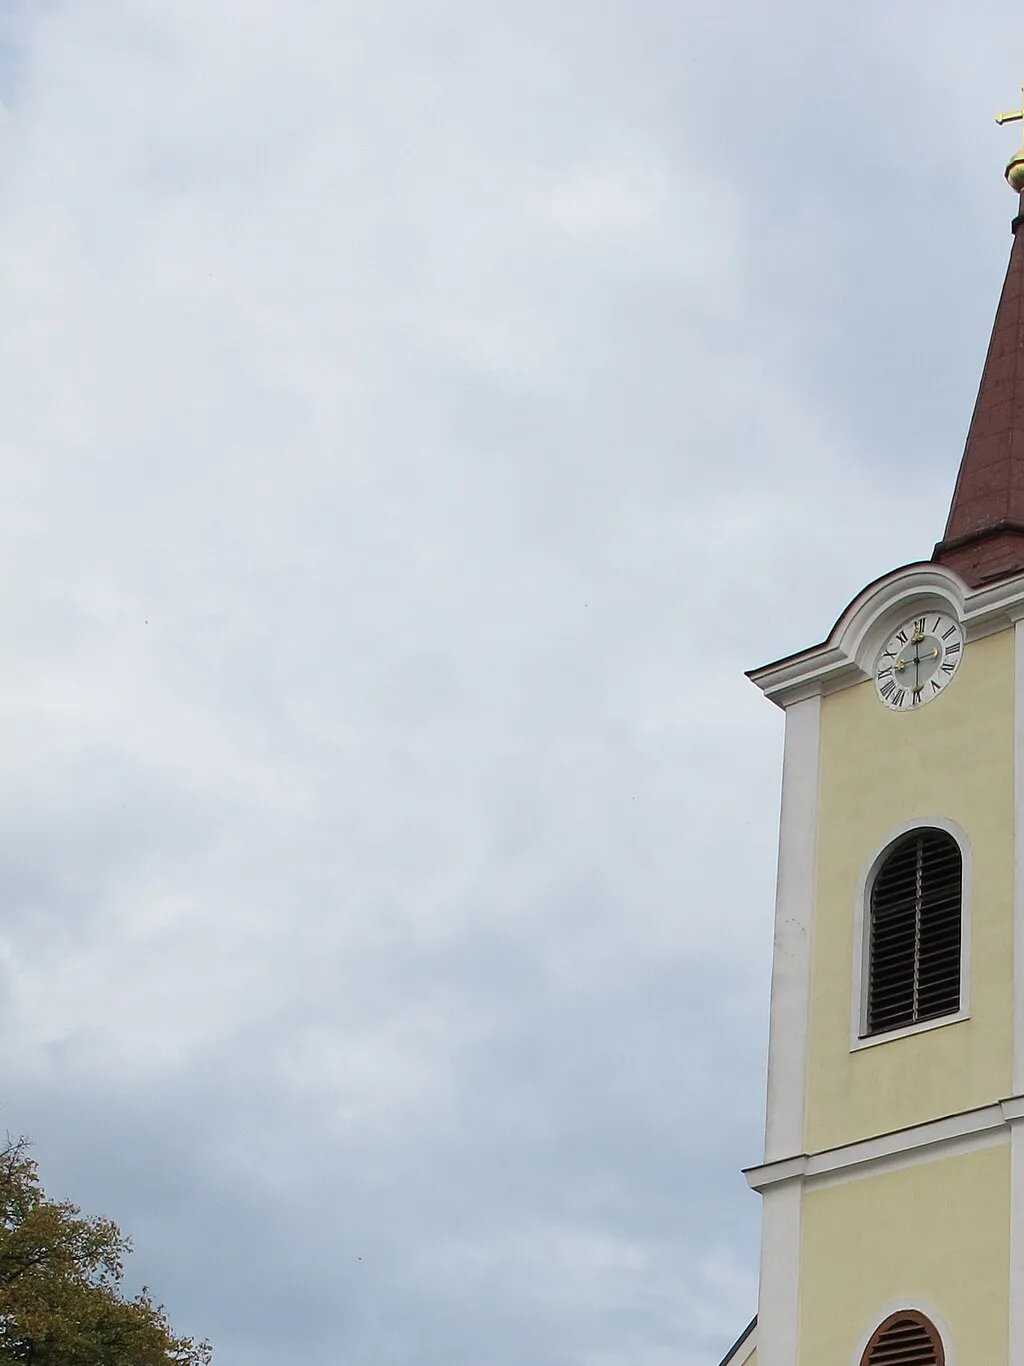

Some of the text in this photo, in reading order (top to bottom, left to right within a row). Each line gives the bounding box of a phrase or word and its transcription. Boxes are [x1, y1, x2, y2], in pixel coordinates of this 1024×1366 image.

[896, 630, 909, 647] XI
[941, 625, 957, 641] II
[882, 649, 898, 660] X
[945, 641, 961, 656] III
[930, 680, 942, 693] V
